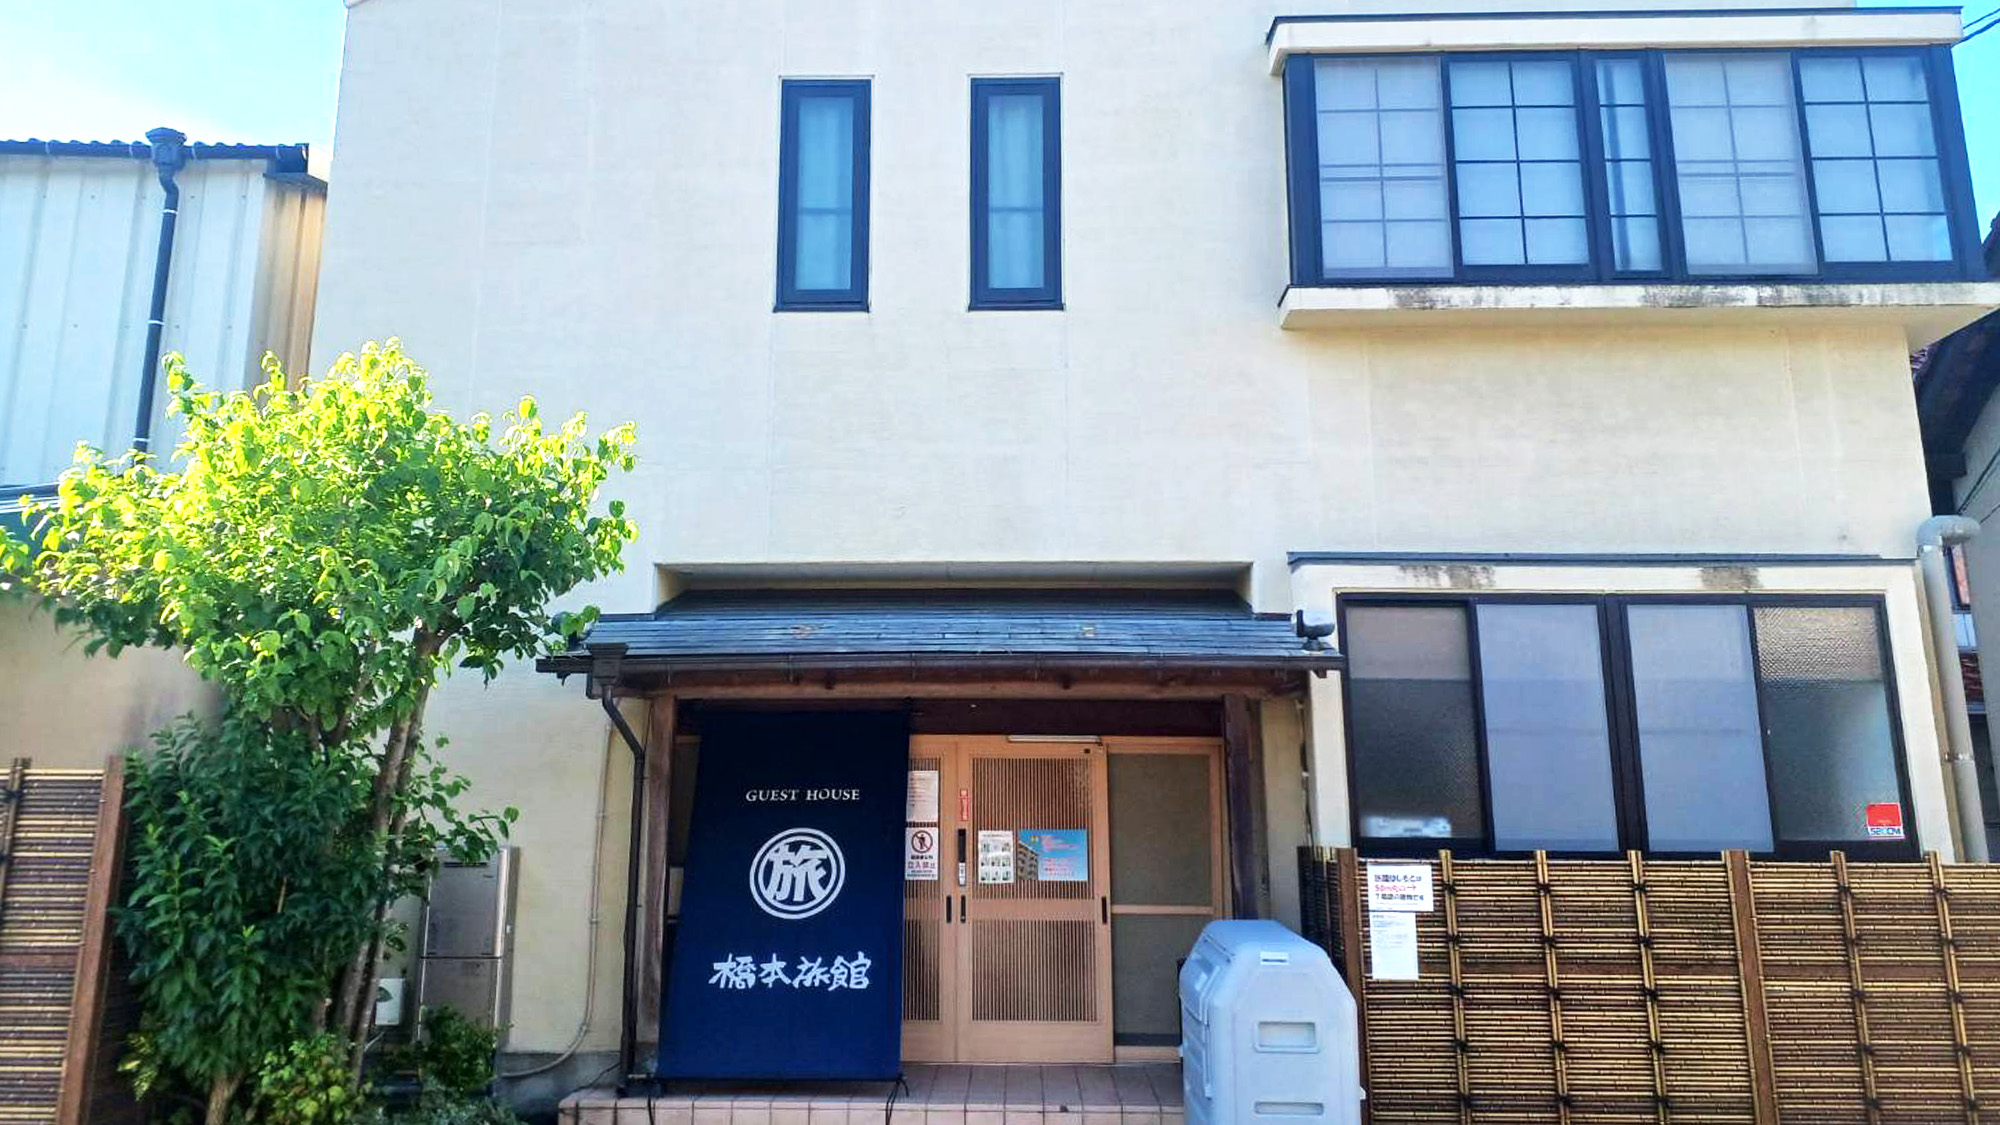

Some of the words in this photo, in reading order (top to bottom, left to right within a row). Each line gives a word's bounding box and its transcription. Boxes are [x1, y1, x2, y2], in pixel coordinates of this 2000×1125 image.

[746, 789, 798, 801] GUEST
[806, 788, 860, 801] HOUSE
[708, 951, 872, 991] 橋本旅館
